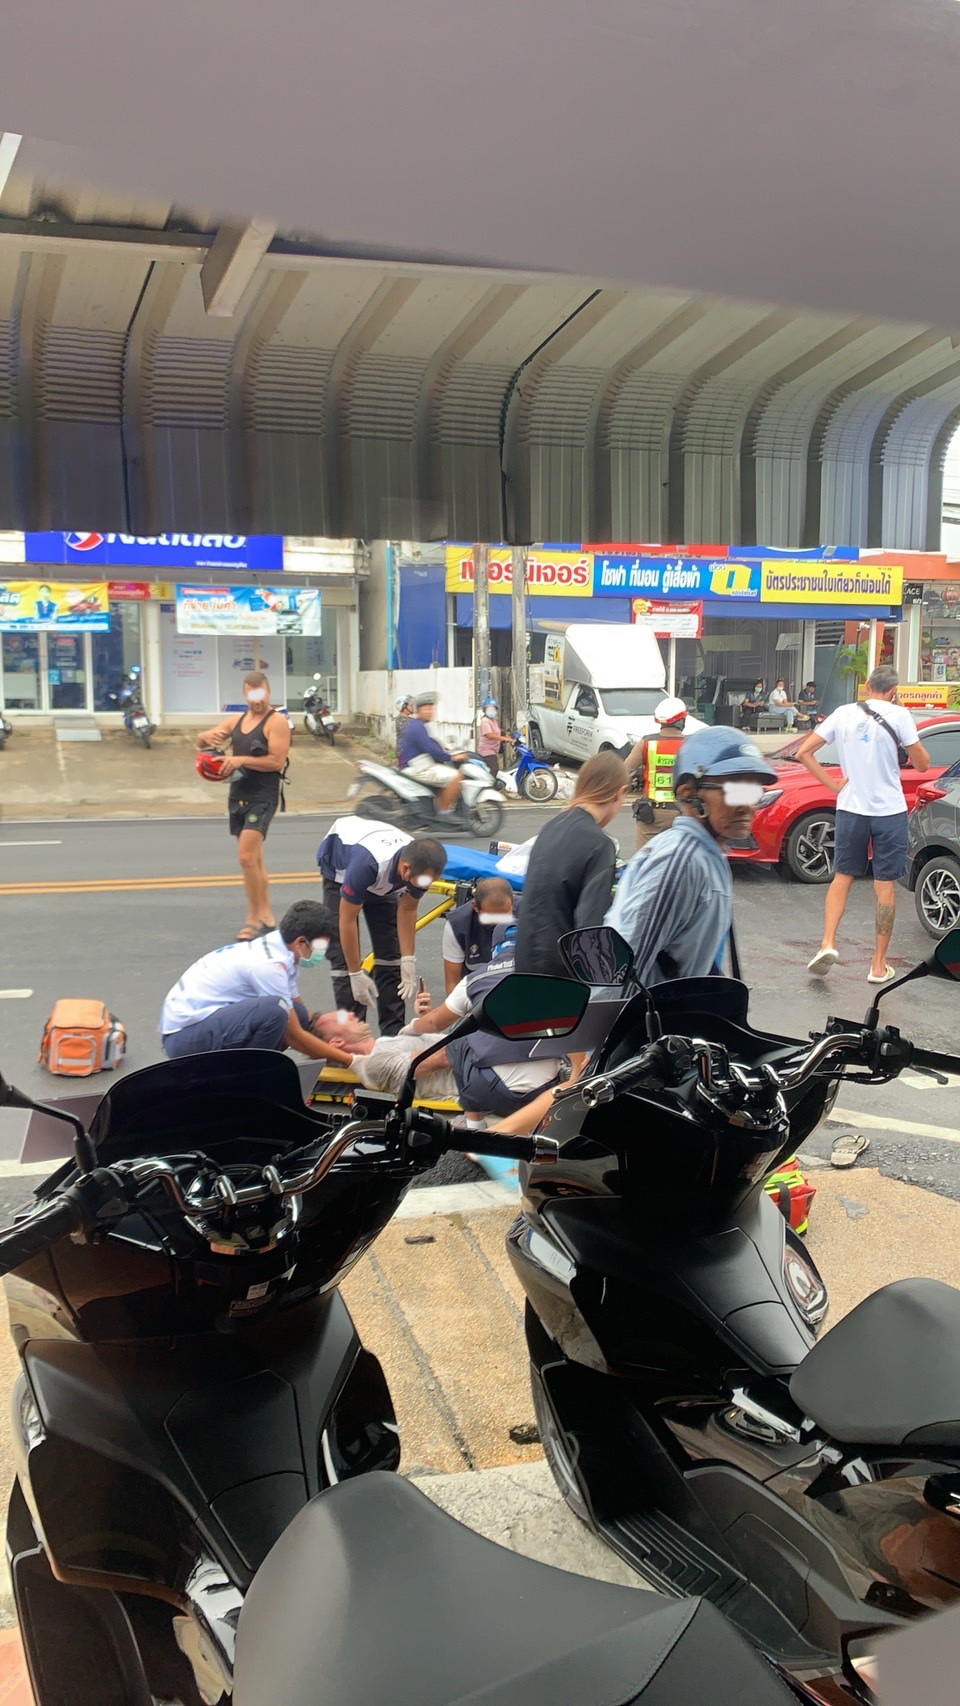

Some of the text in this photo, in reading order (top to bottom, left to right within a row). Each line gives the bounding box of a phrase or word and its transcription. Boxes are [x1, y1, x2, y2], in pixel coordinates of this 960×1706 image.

[629, 559, 660, 587] ที่นอน
[662, 560, 700, 593] ตู้เสื้อผ้า
[766, 570, 892, 595] บัตรประชาชนใบเดียวก็ผ่อนได้
